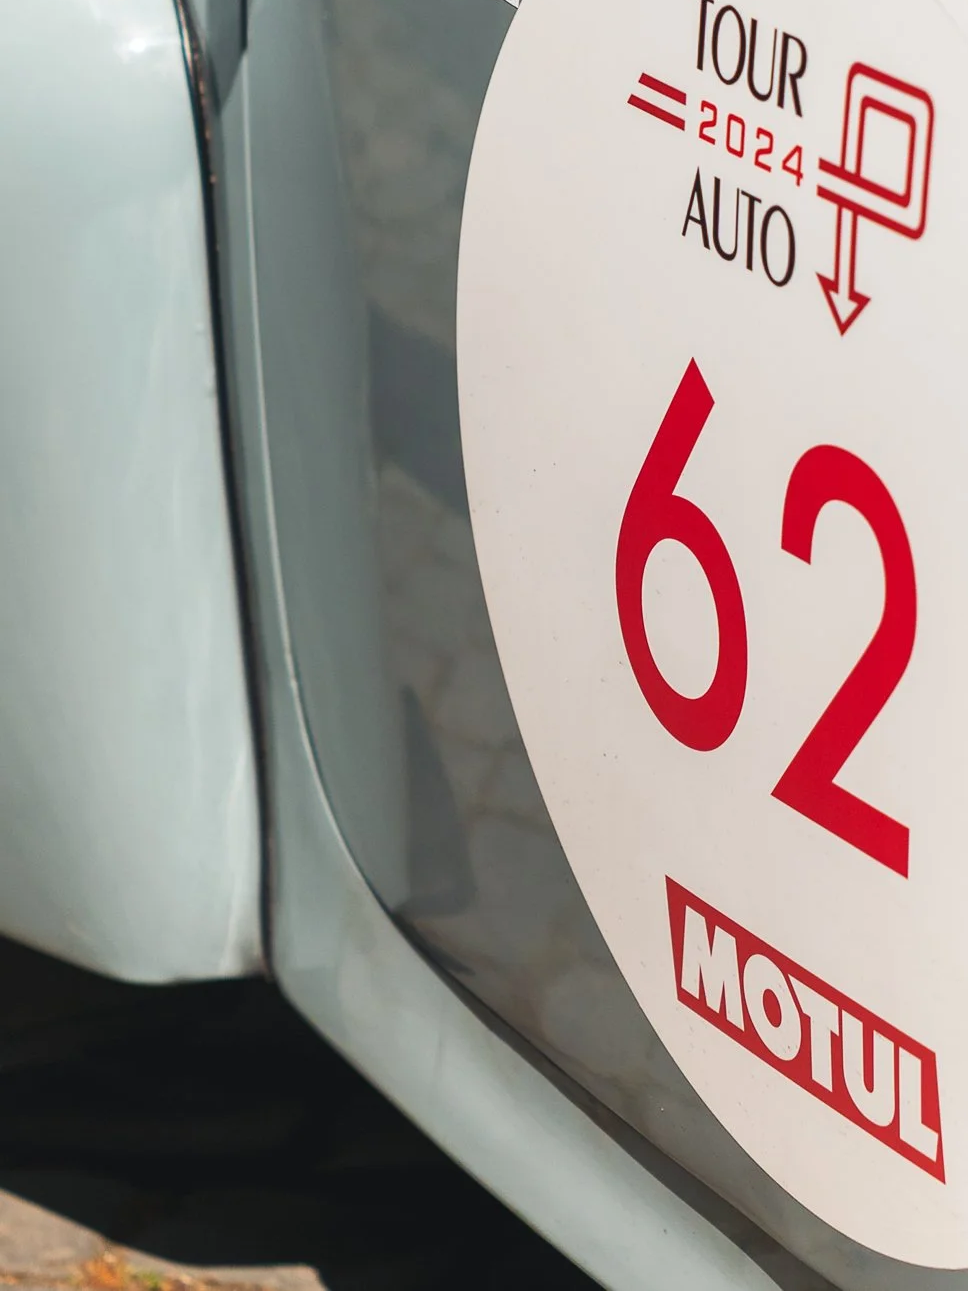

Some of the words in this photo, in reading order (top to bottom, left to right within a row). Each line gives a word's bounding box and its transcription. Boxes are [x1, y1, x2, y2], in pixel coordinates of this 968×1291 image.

[681, 166, 796, 288] AUTO
[698, 100, 804, 187] 2024
[615, 357, 918, 880] 62
[679, 904, 941, 1164] MOTUL
